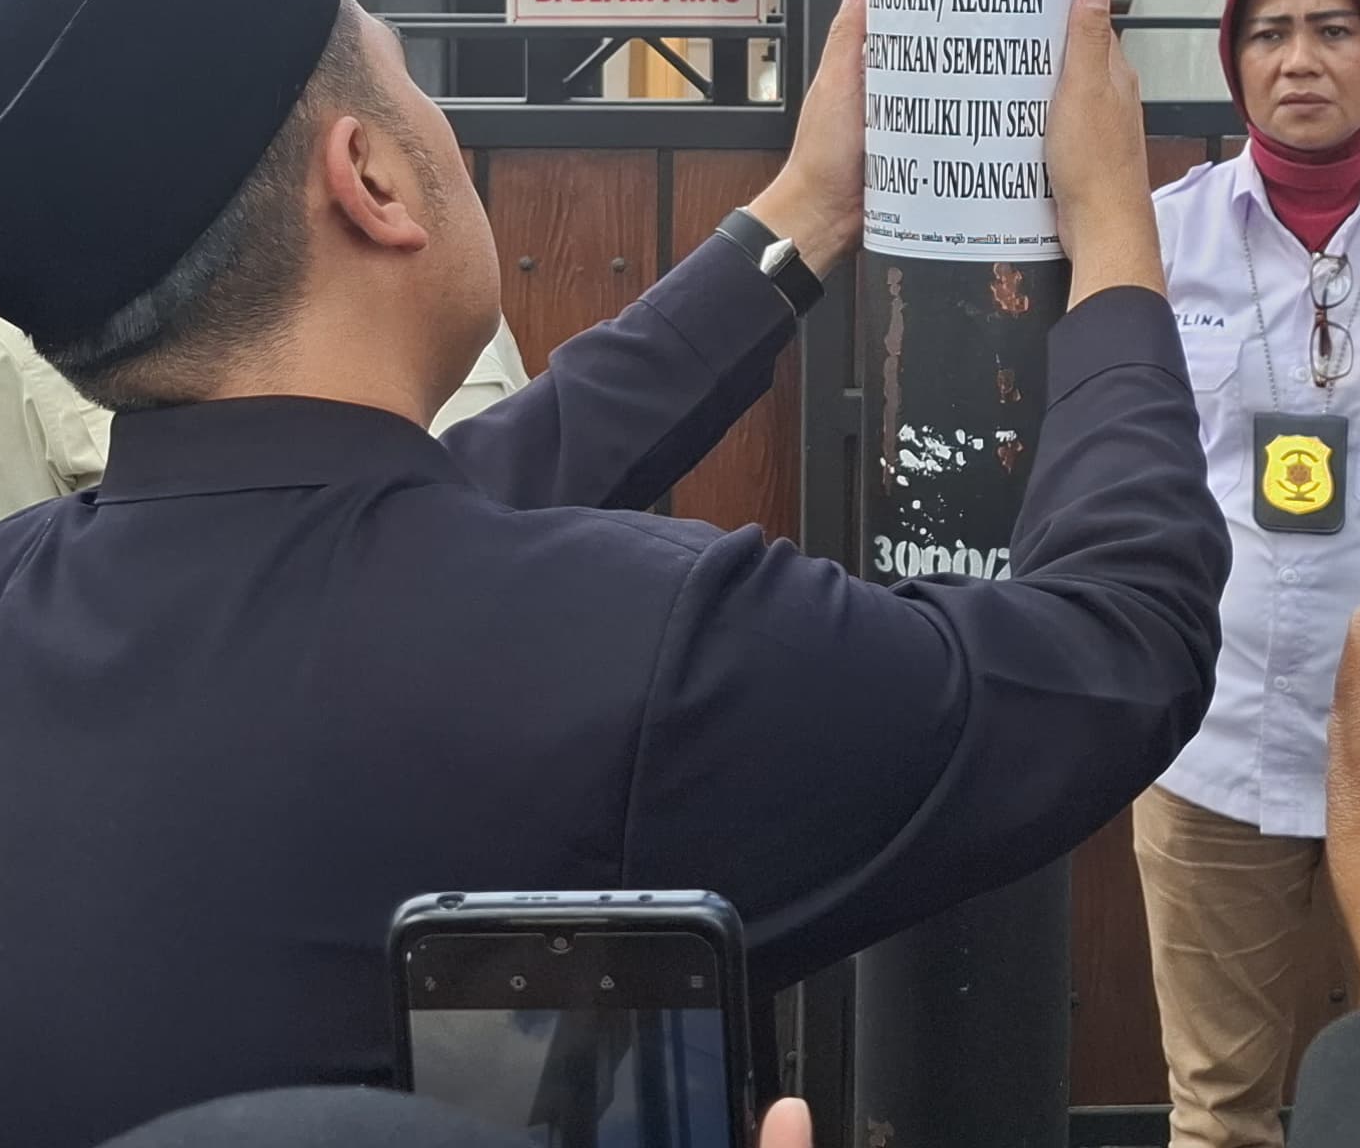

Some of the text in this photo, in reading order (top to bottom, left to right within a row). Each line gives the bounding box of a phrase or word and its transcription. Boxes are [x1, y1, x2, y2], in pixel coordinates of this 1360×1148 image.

[867, 33, 1052, 75] HENTIKAN SEMENTARA
[884, 95, 962, 137] MEMILIKI
[966, 100, 1002, 146] IJIN
[933, 161, 1038, 200] UNDANGAN
